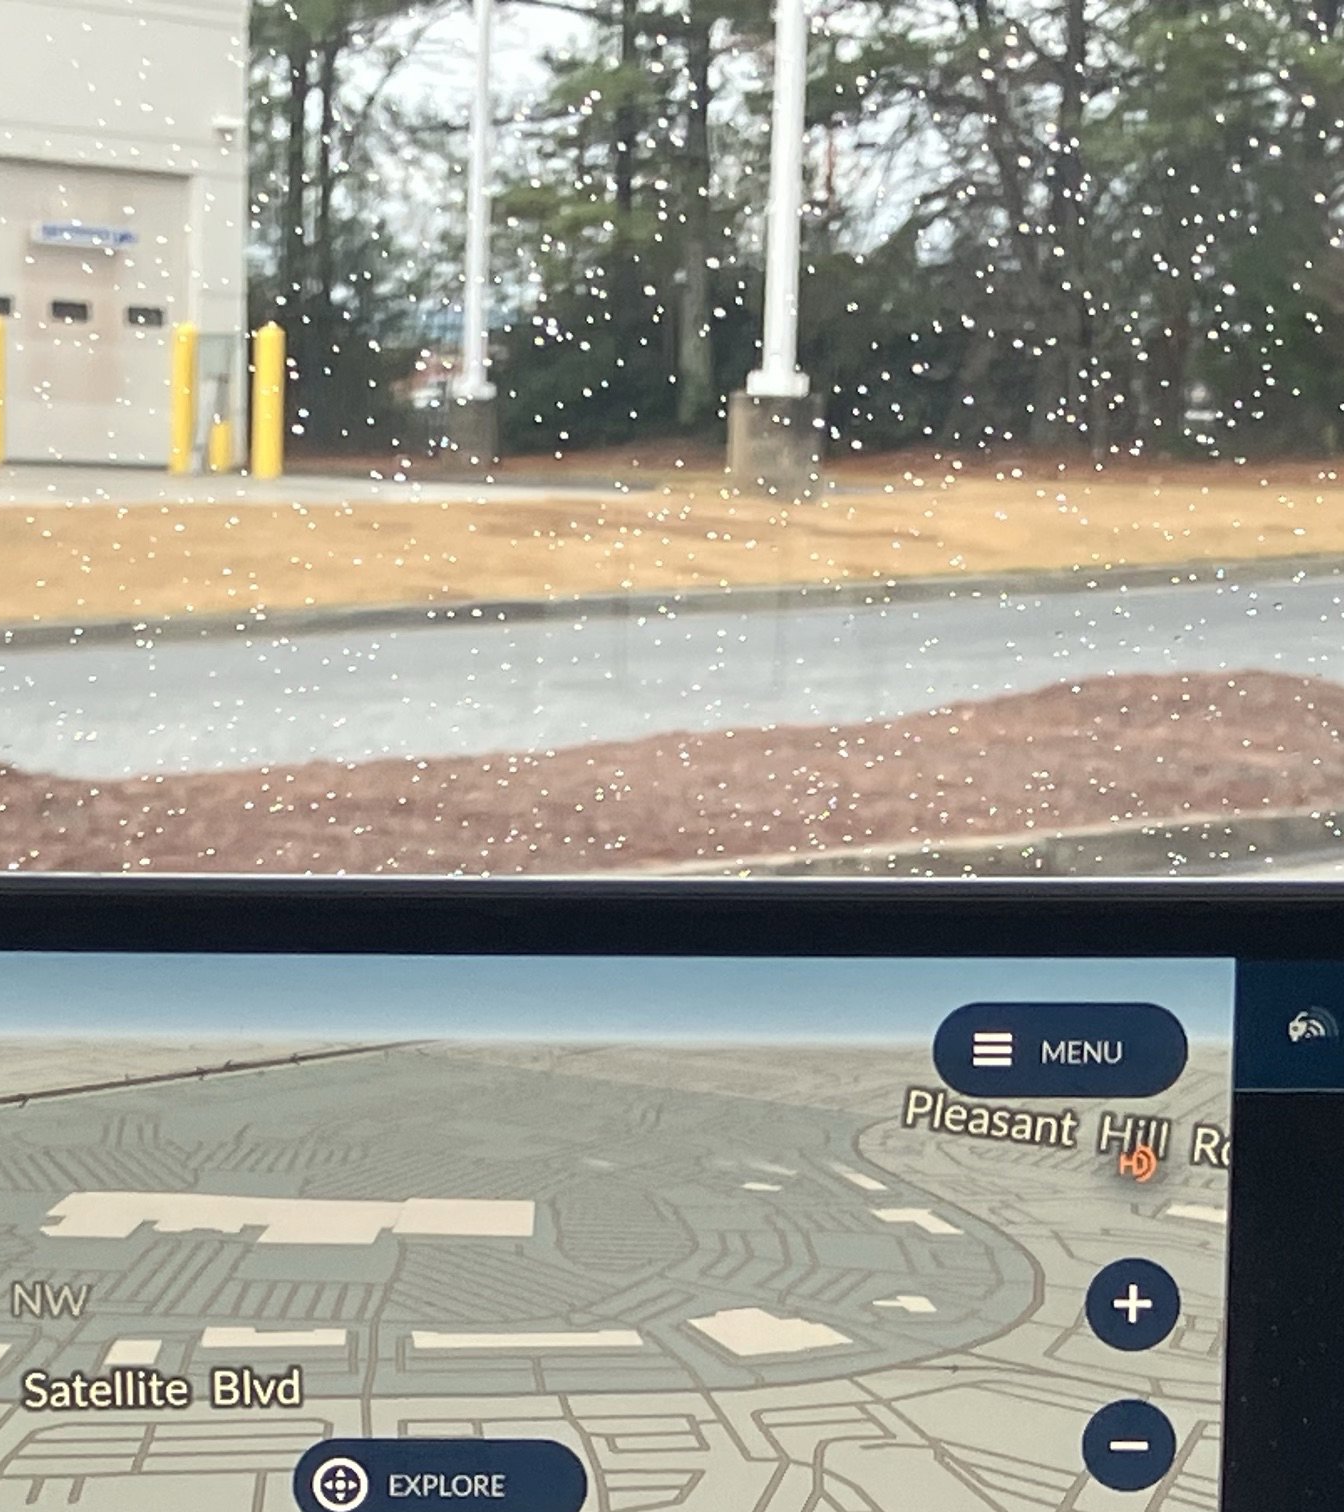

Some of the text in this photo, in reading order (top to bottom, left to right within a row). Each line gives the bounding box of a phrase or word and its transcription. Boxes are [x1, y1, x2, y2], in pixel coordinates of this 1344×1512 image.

[1040, 1040, 1124, 1065] MENU
[905, 1088, 1078, 1147] Pleasant
[1099, 1114, 1169, 1158] Hill
[13, 1283, 90, 1316] NW
[23, 1368, 302, 1408] Satellite Blvd
[388, 1473, 507, 1499] EXPLORE
